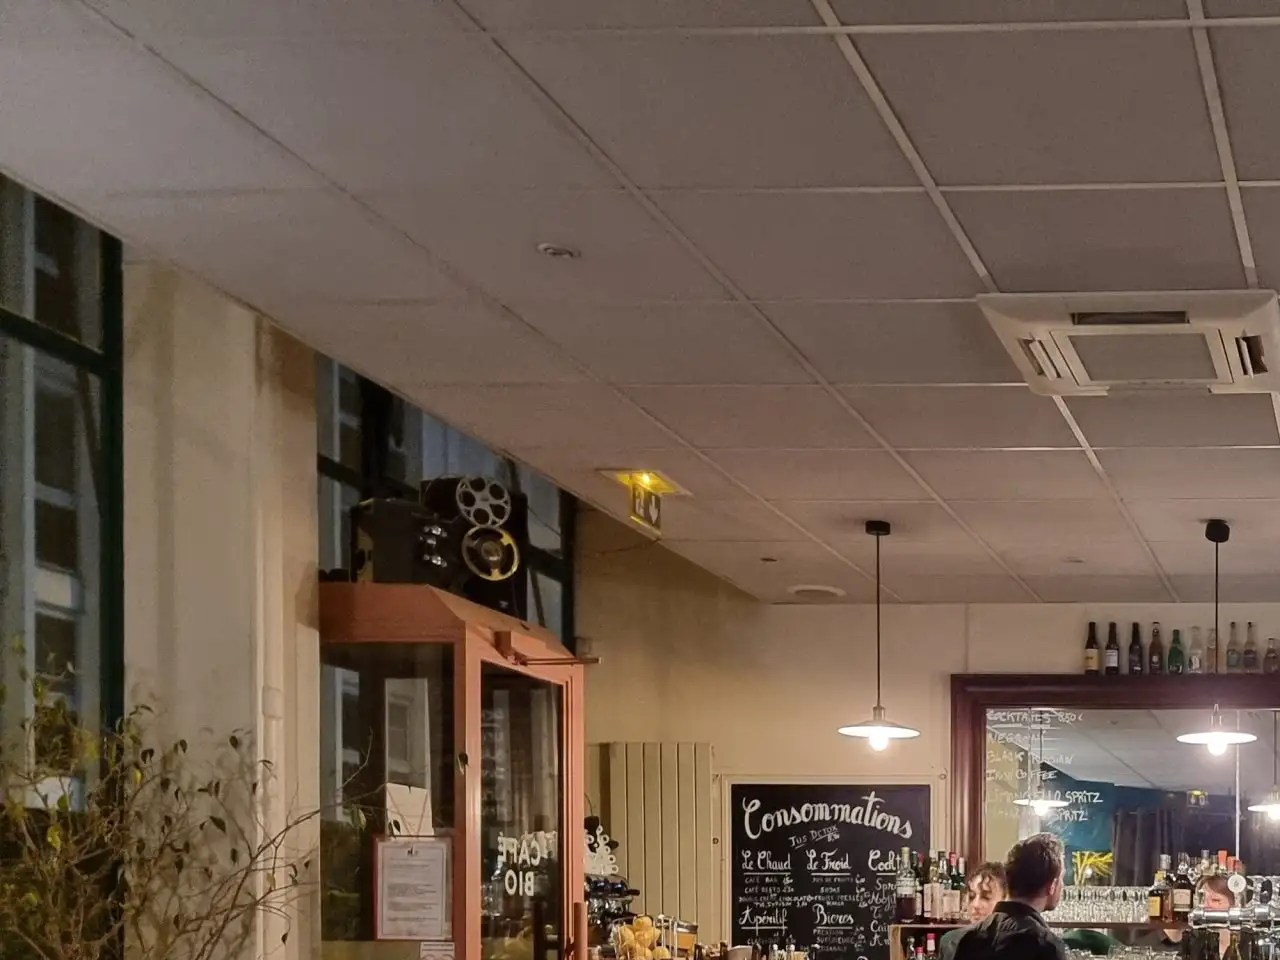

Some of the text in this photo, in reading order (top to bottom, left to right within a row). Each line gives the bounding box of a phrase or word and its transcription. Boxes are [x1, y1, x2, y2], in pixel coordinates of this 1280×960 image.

[742, 791, 913, 840] Consommations
[742, 850, 791, 871] Le Chaud
[806, 848, 852, 871] Le Froid
